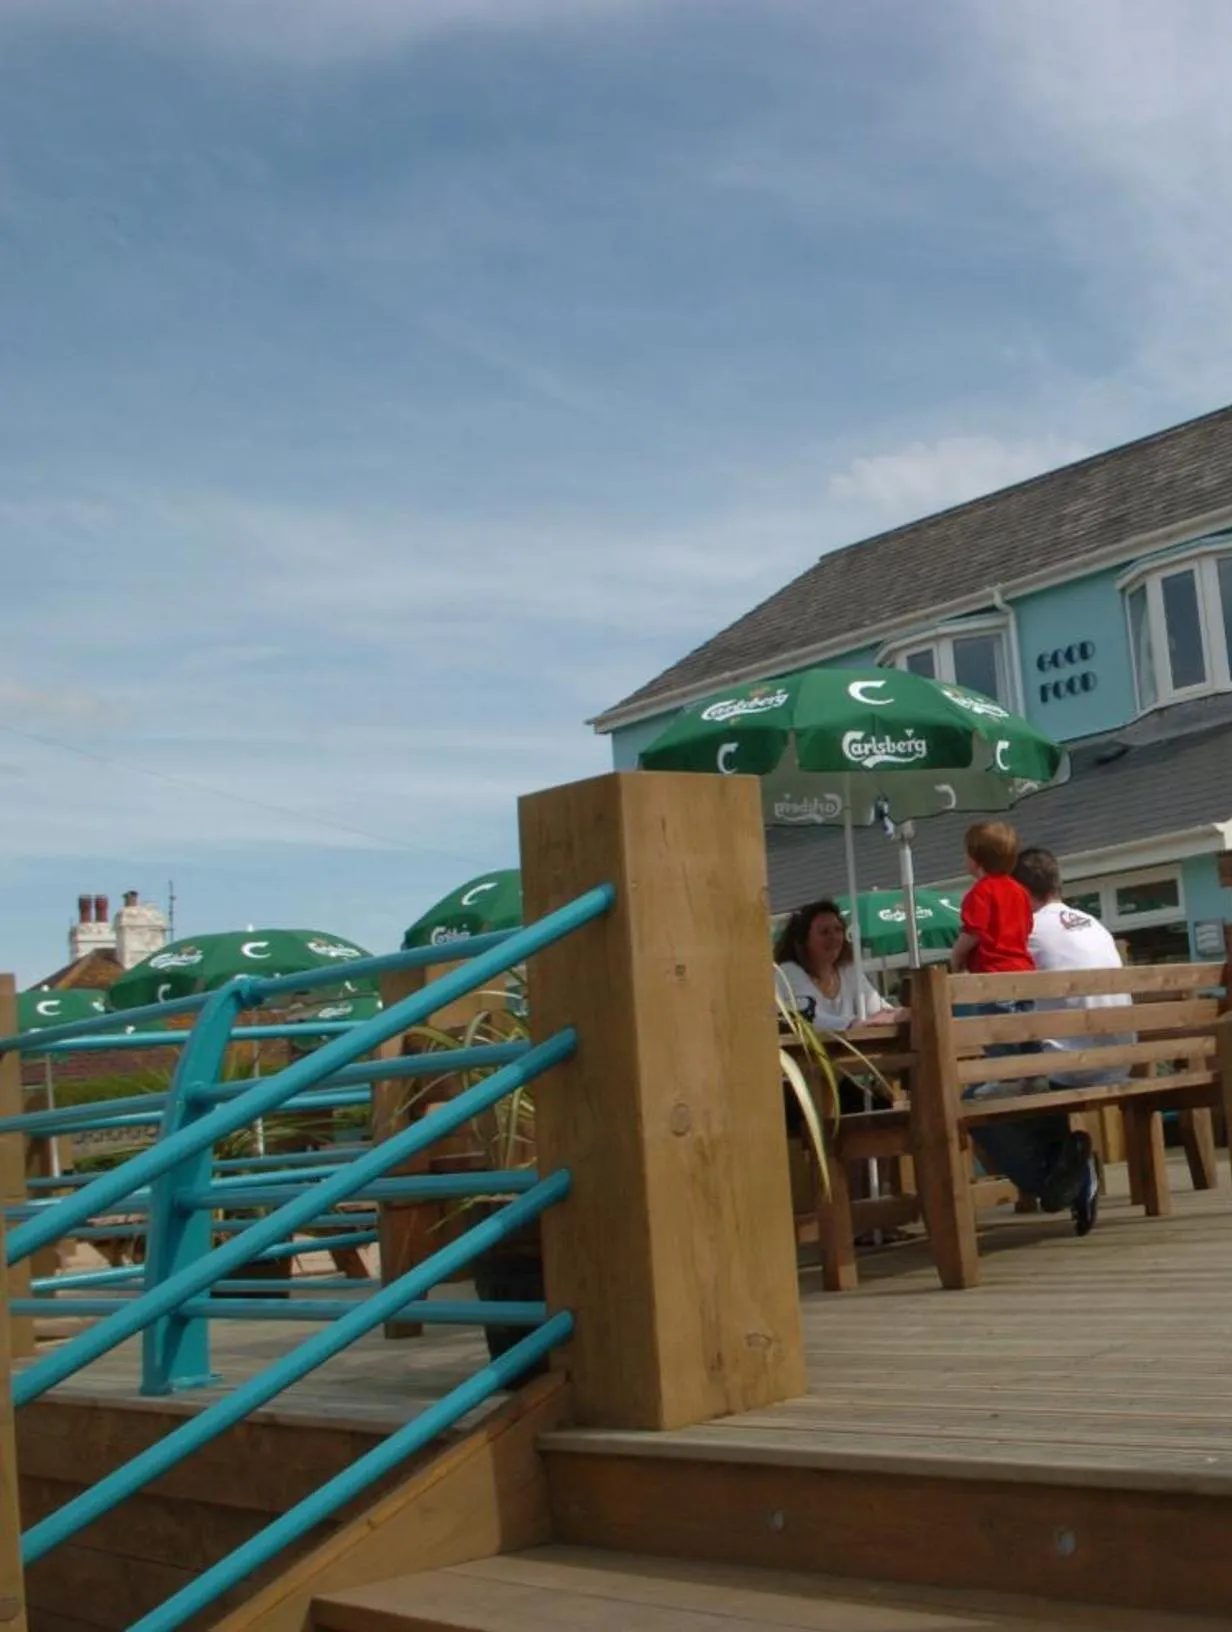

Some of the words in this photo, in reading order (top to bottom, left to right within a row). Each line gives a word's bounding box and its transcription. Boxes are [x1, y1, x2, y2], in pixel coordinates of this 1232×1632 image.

[1036, 640, 1096, 672] GOOD
[1040, 671, 1098, 703] FOOD
[842, 728, 927, 768] Carlsberg
